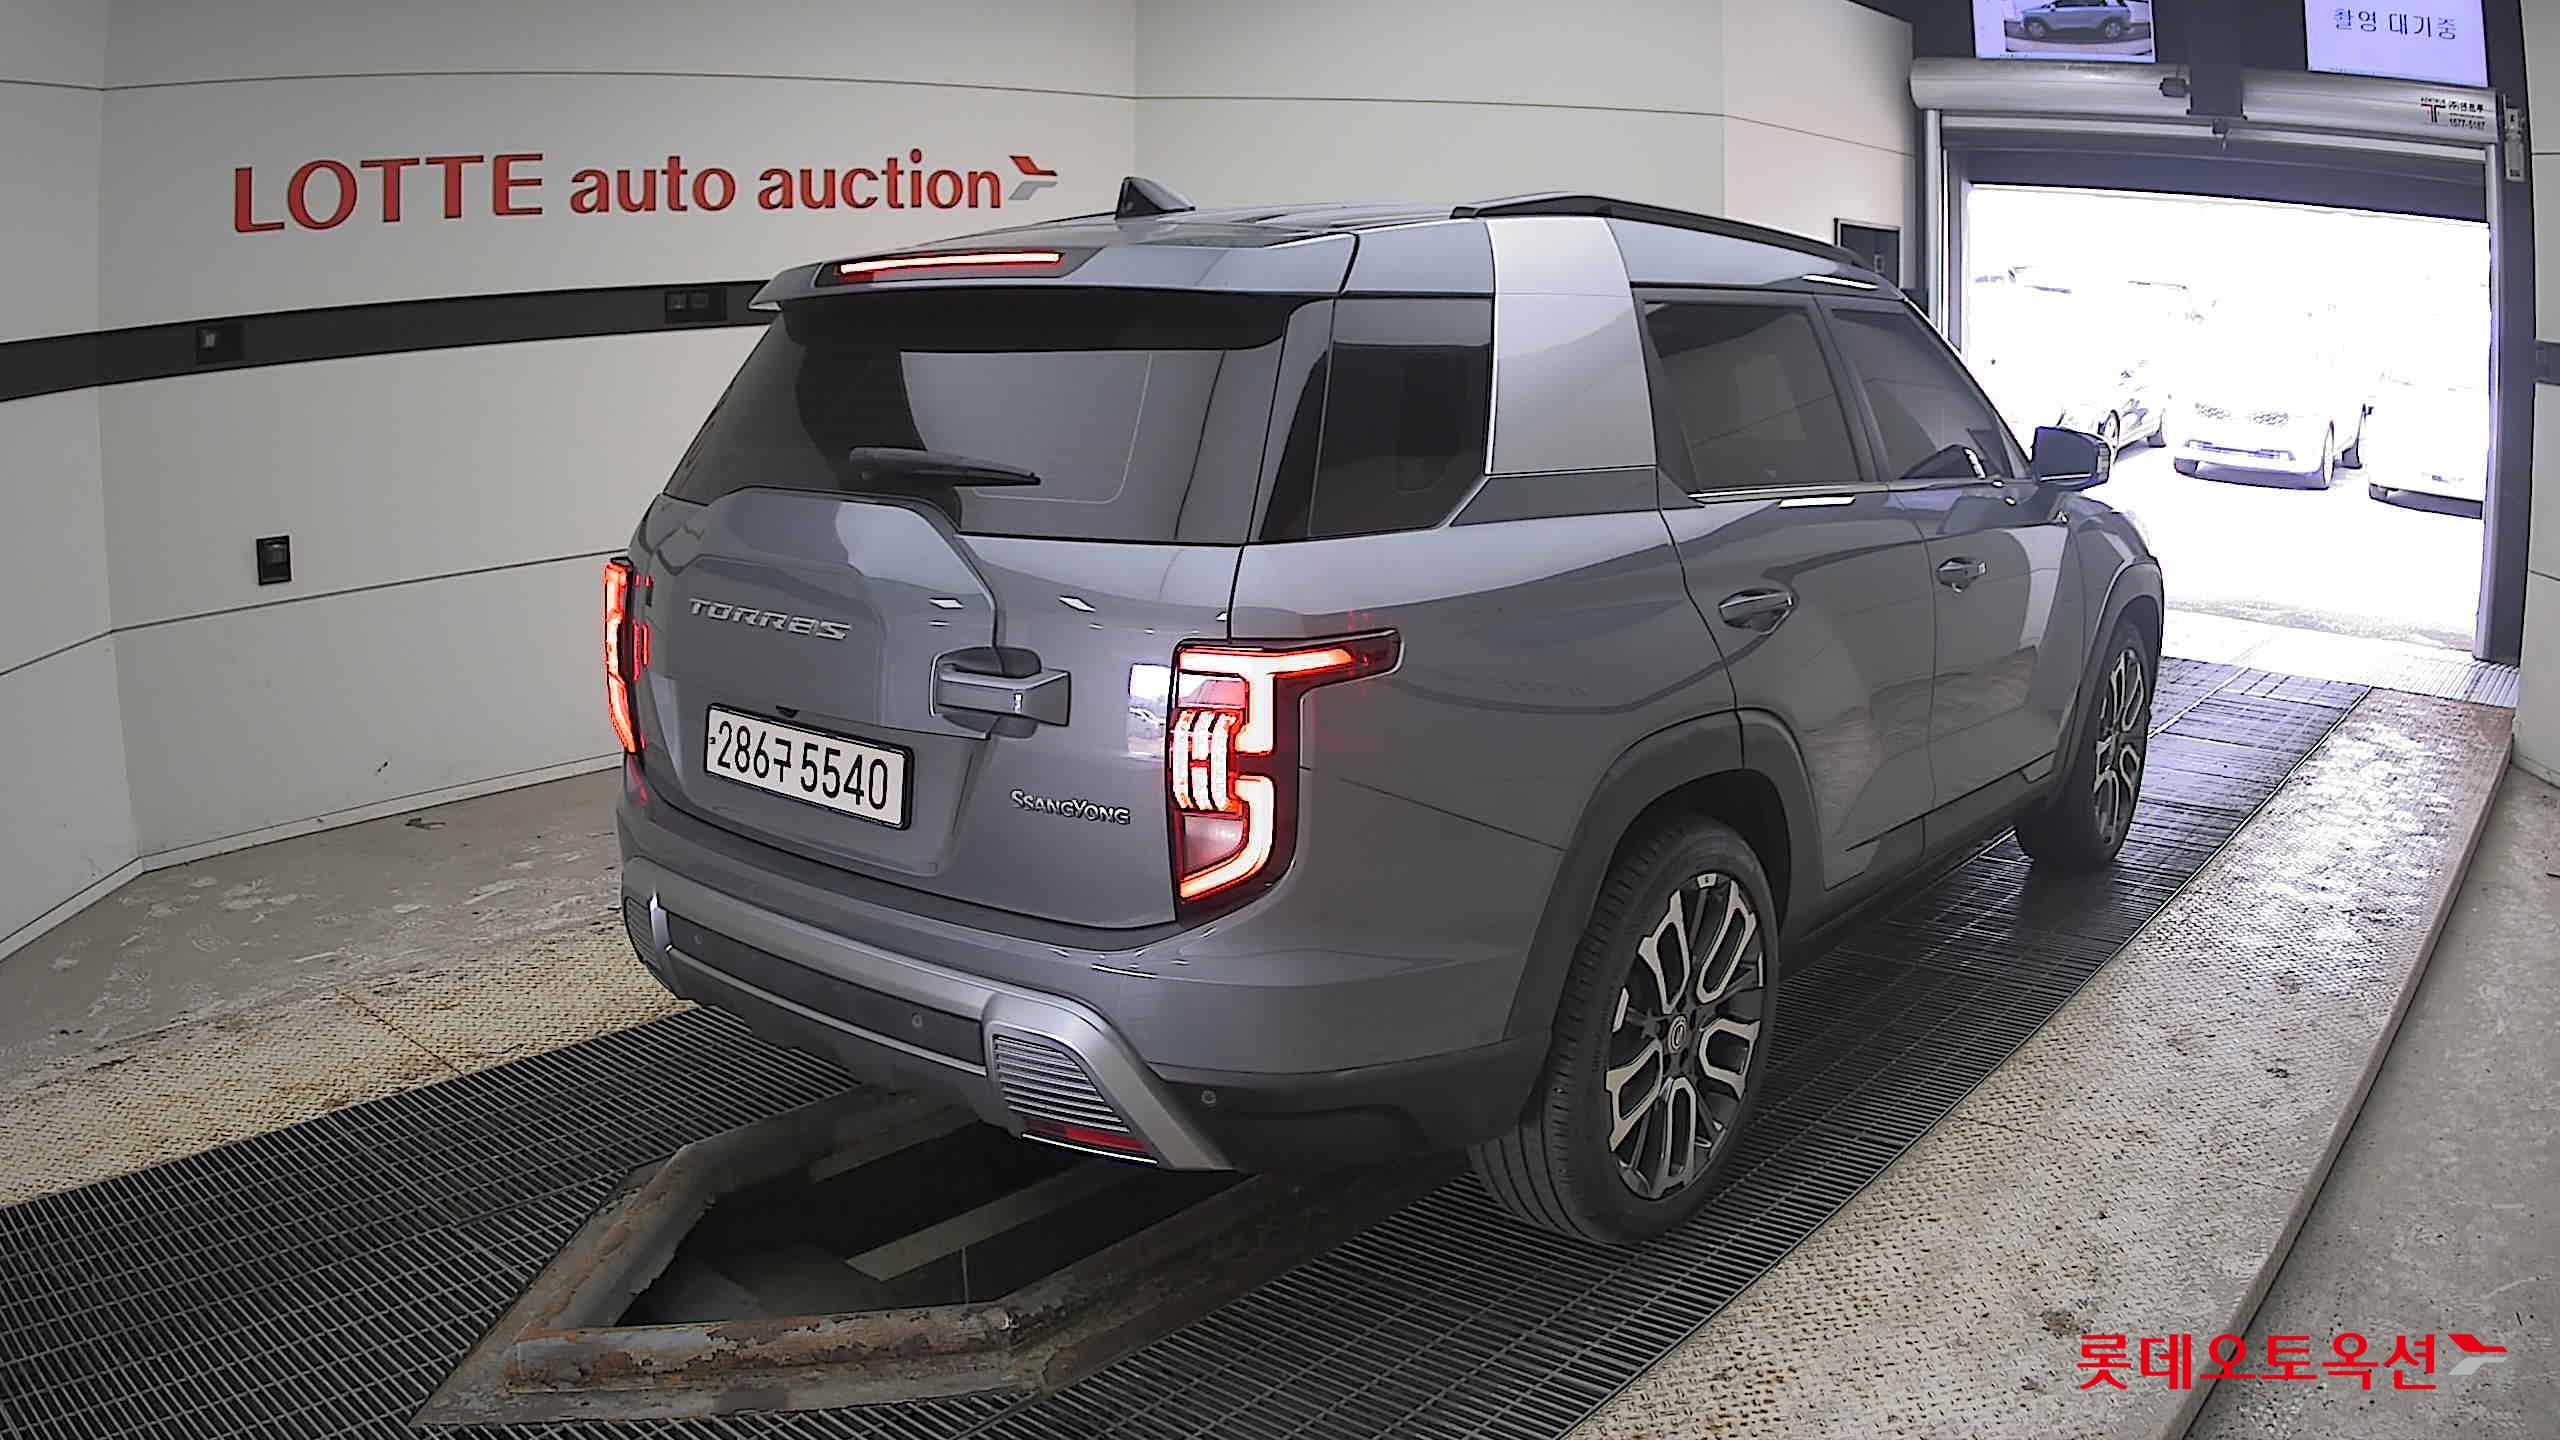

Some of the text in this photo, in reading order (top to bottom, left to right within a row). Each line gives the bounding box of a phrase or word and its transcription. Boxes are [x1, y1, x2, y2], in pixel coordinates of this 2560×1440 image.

[2389, 13, 2457, 40] 대기중
[234, 148, 1002, 234] LOTTE auto auction
[689, 597, 853, 641] TORRES
[717, 720, 888, 810] 286구 5540
